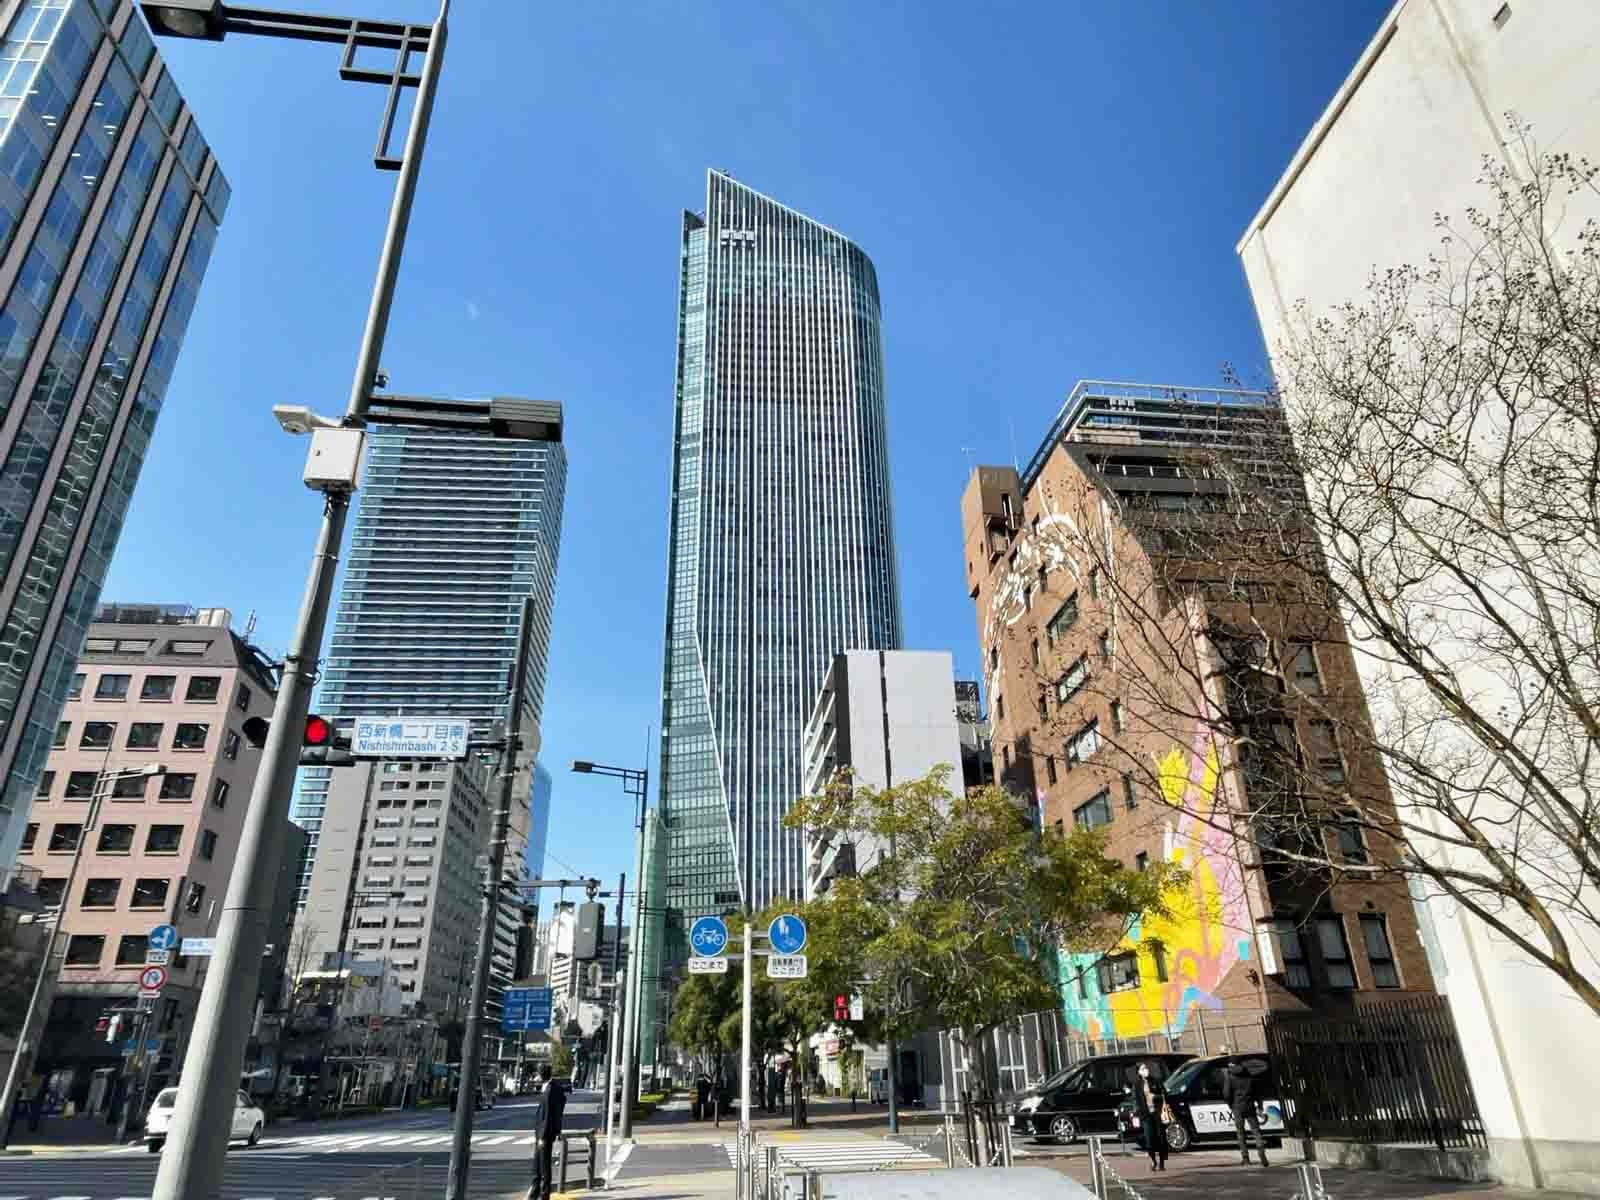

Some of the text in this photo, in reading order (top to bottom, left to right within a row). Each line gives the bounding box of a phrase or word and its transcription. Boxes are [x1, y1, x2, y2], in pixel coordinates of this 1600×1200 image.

[359, 740, 459, 752] Nishishinbashi 2 S
